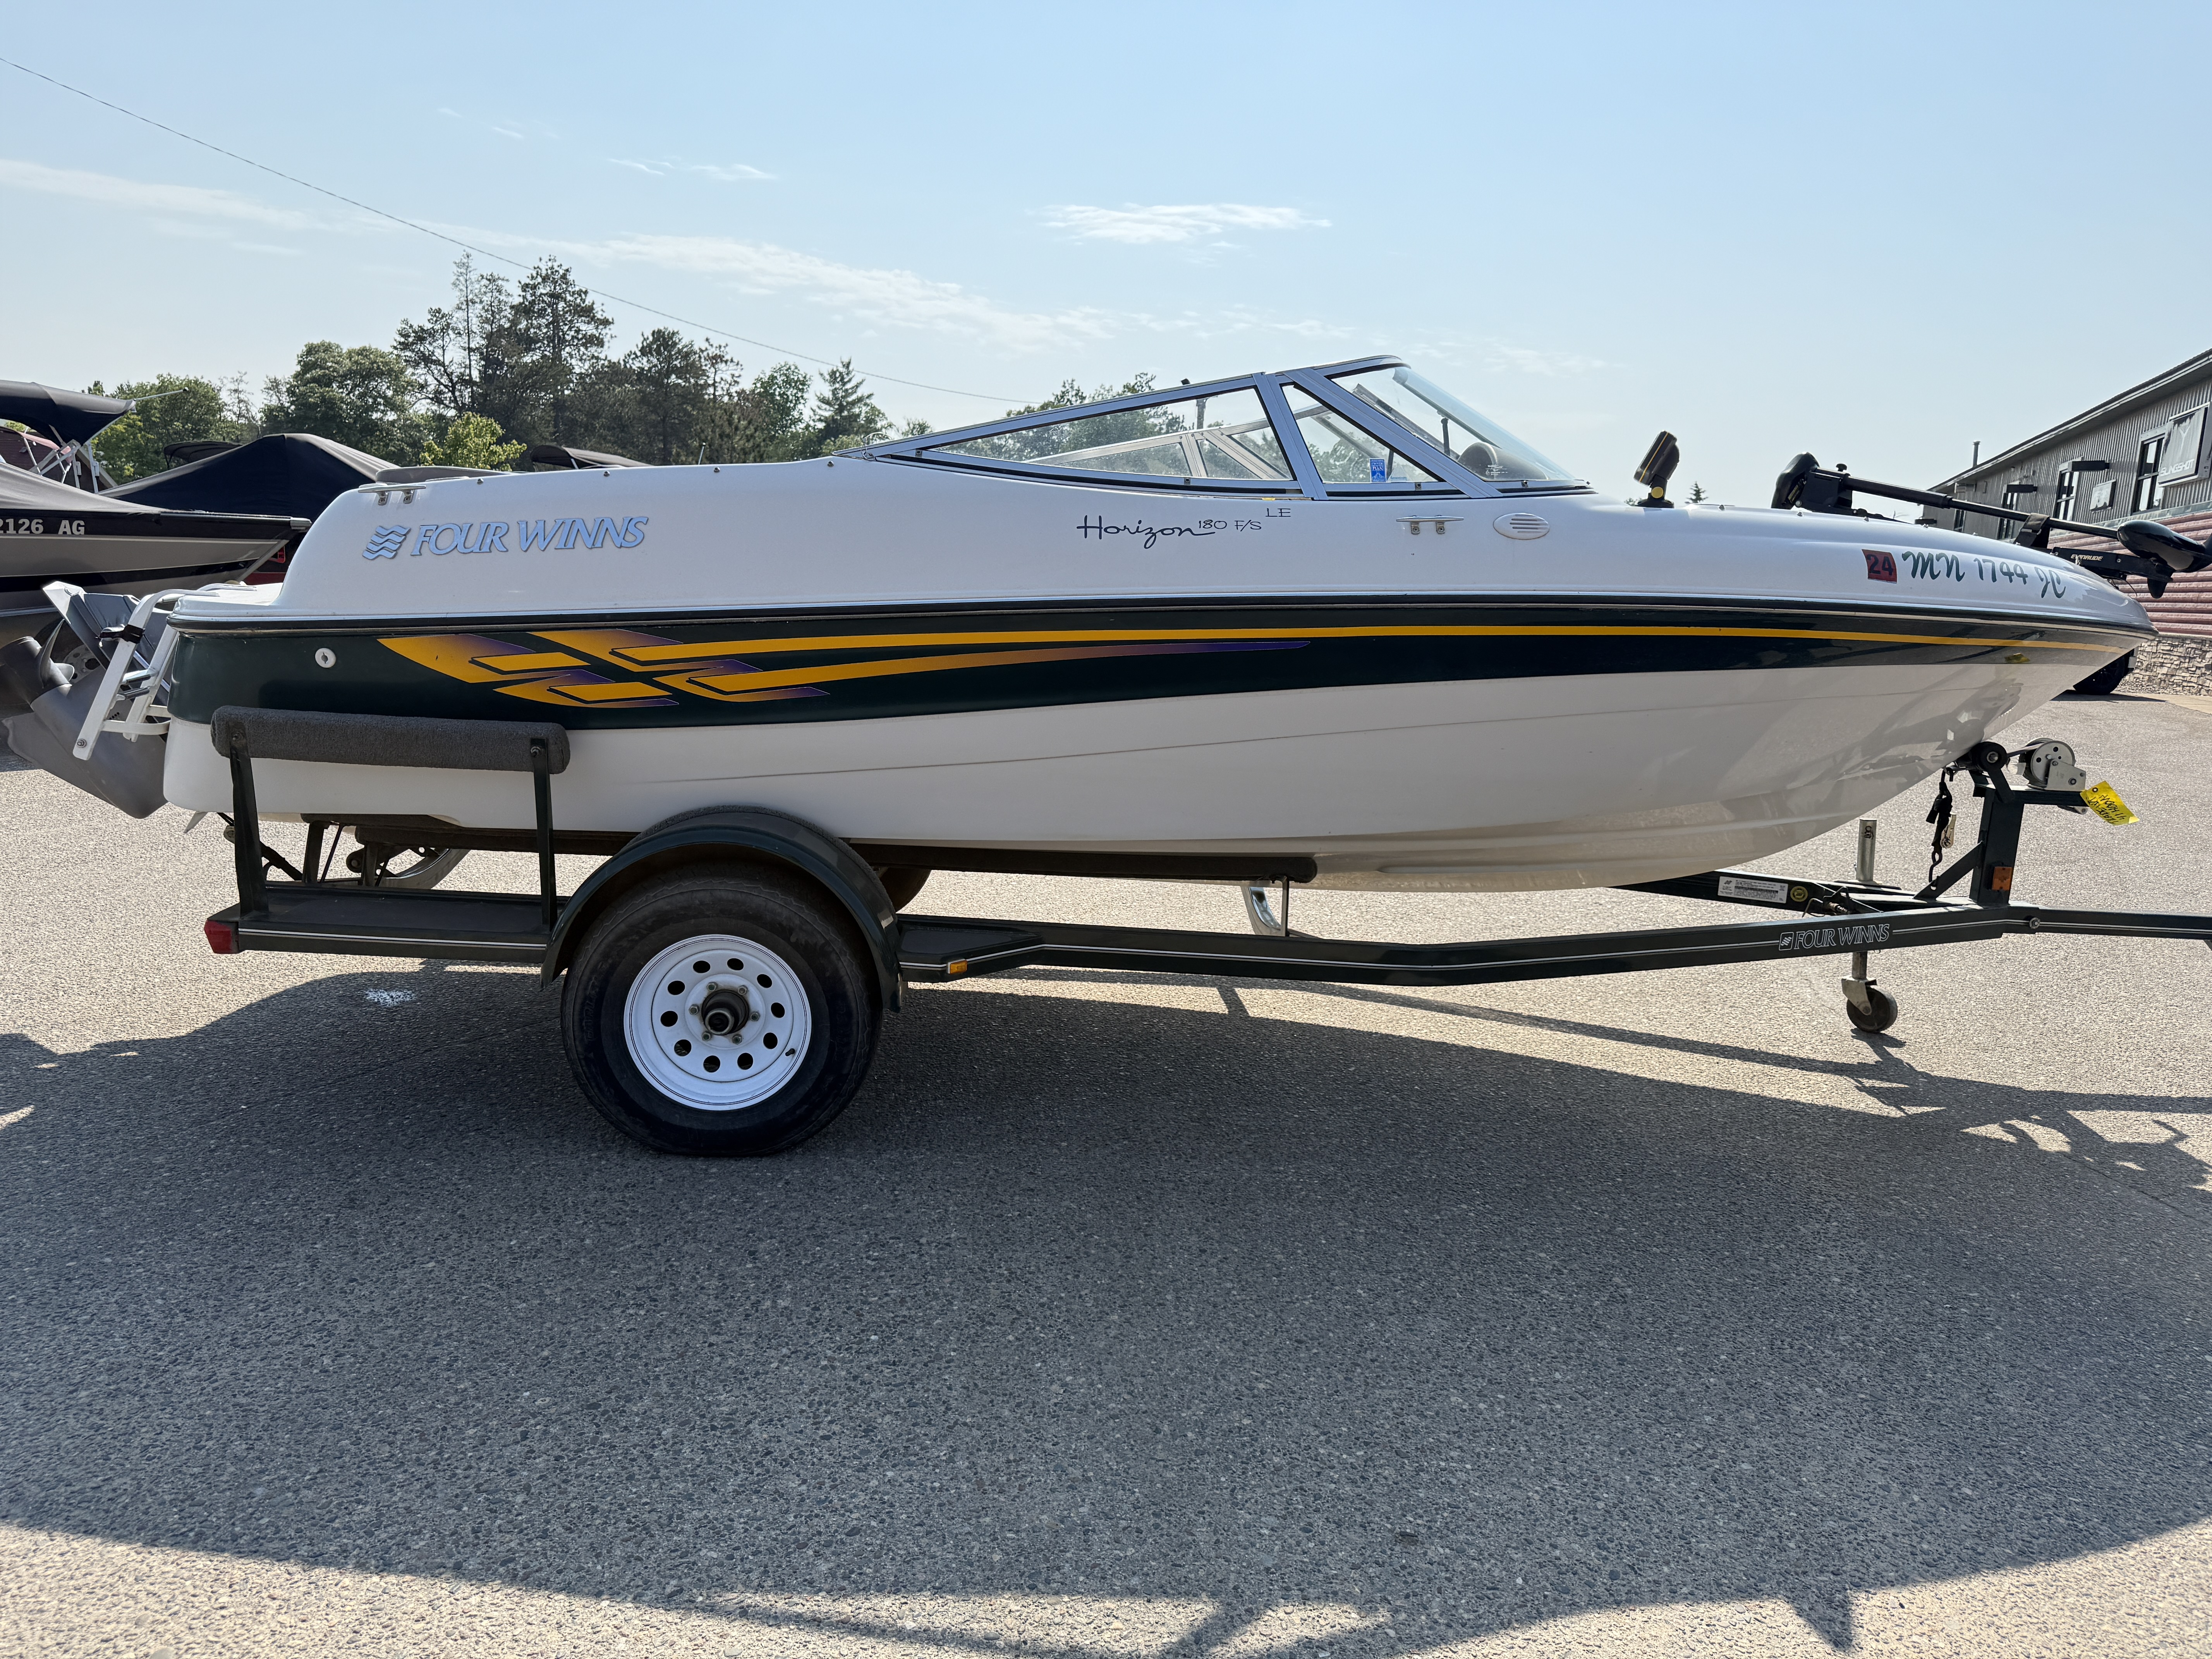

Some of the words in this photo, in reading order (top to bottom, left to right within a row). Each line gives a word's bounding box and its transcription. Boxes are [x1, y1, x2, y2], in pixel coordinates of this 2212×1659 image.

[2160, 458, 2195, 477] SLINGSHOT
[1265, 507, 1291, 517] LE
[58, 520, 85, 535] AG
[410, 522, 509, 556] FOUR
[517, 516, 649, 552] WINNS
[1076, 515, 1216, 550] Horizon
[1199, 519, 1228, 529] 180
[1234, 520, 1262, 532] F/S
[1865, 553, 1894, 576] 24
[1901, 551, 1965, 582] MN
[1973, 557, 2028, 585] 1744
[1794, 928, 1837, 950] FOUR
[1838, 924, 1890, 946] WINNS
